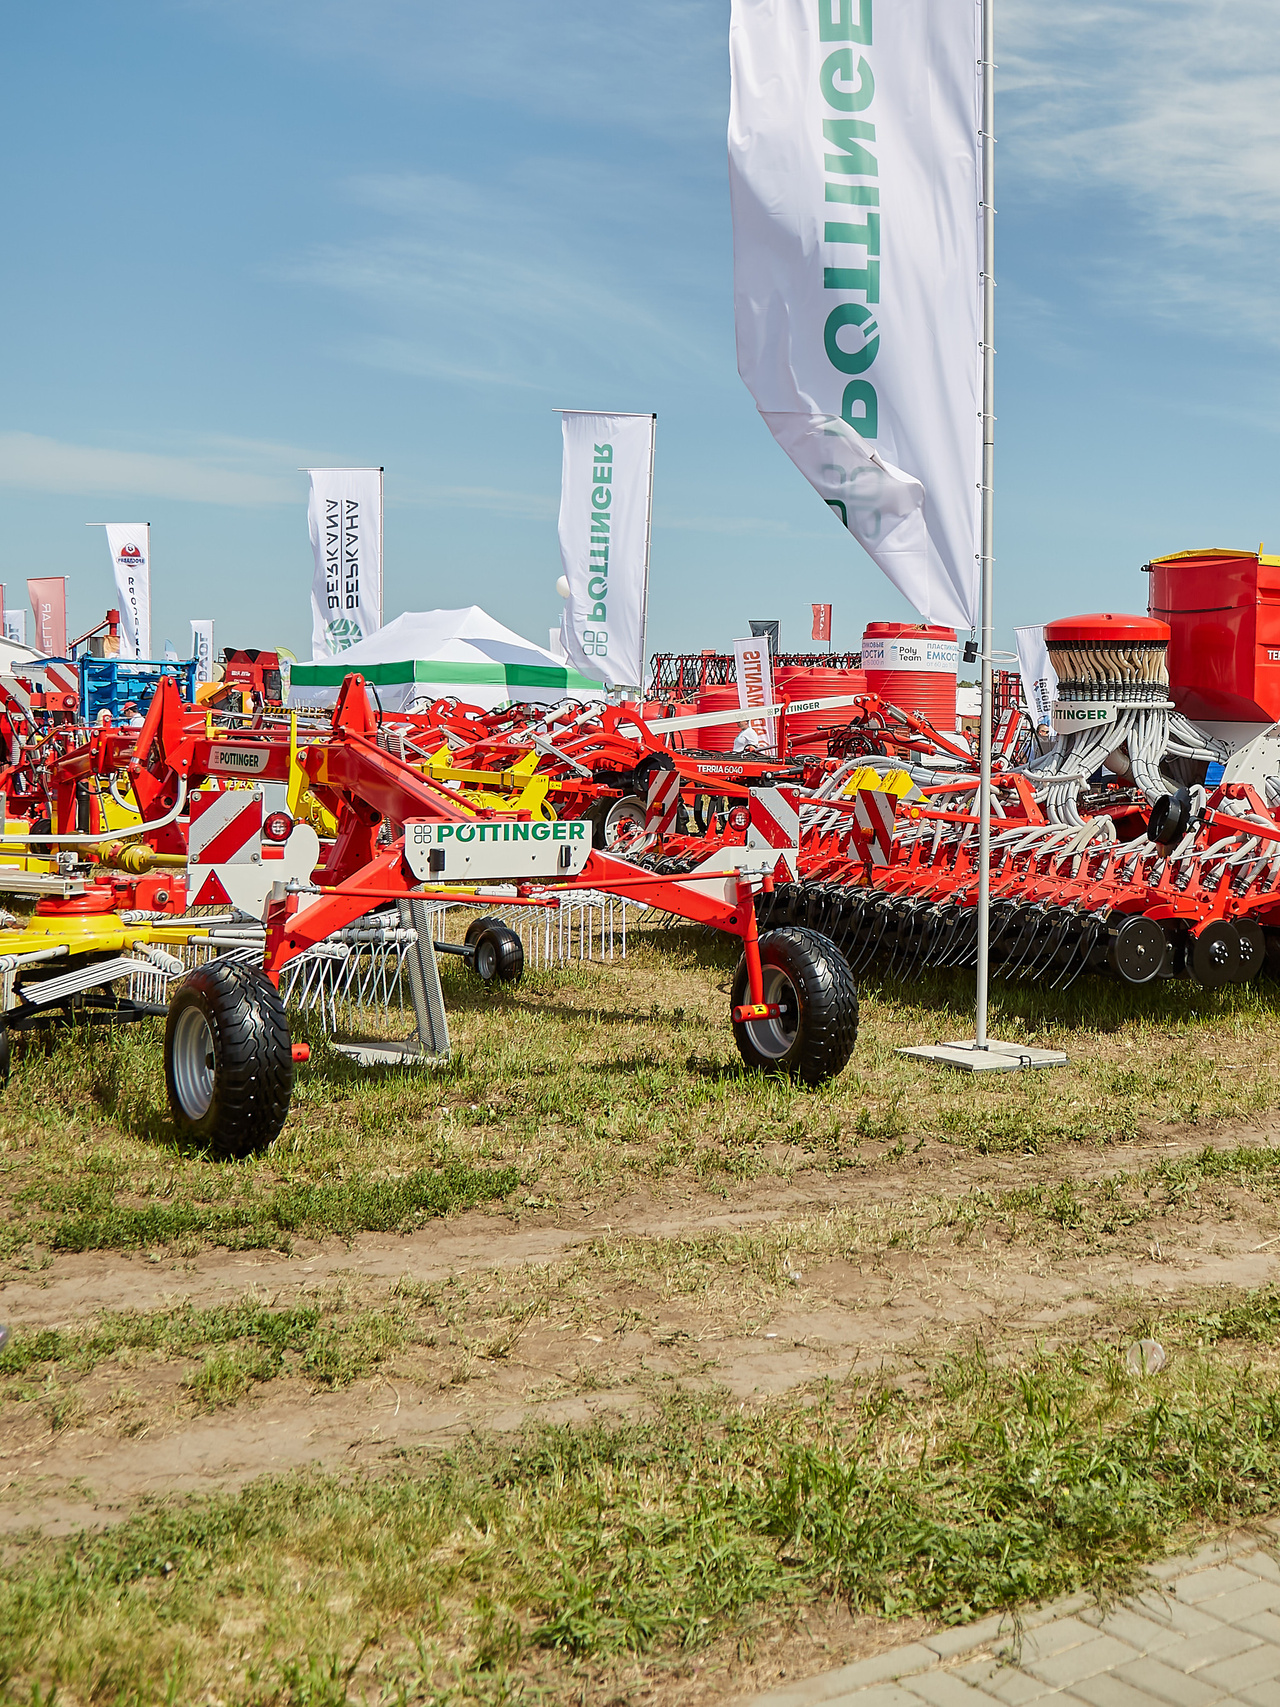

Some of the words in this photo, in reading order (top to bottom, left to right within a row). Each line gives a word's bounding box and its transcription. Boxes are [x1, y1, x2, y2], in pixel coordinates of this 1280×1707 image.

[899, 646, 918, 655] Poly
[926, 650, 957, 662] ЕМКОСТ
[899, 653, 922, 662] Team
[774, 701, 820, 715] PTTINGER
[696, 764, 724, 774] TERRIA
[724, 765, 744, 775] 6040
